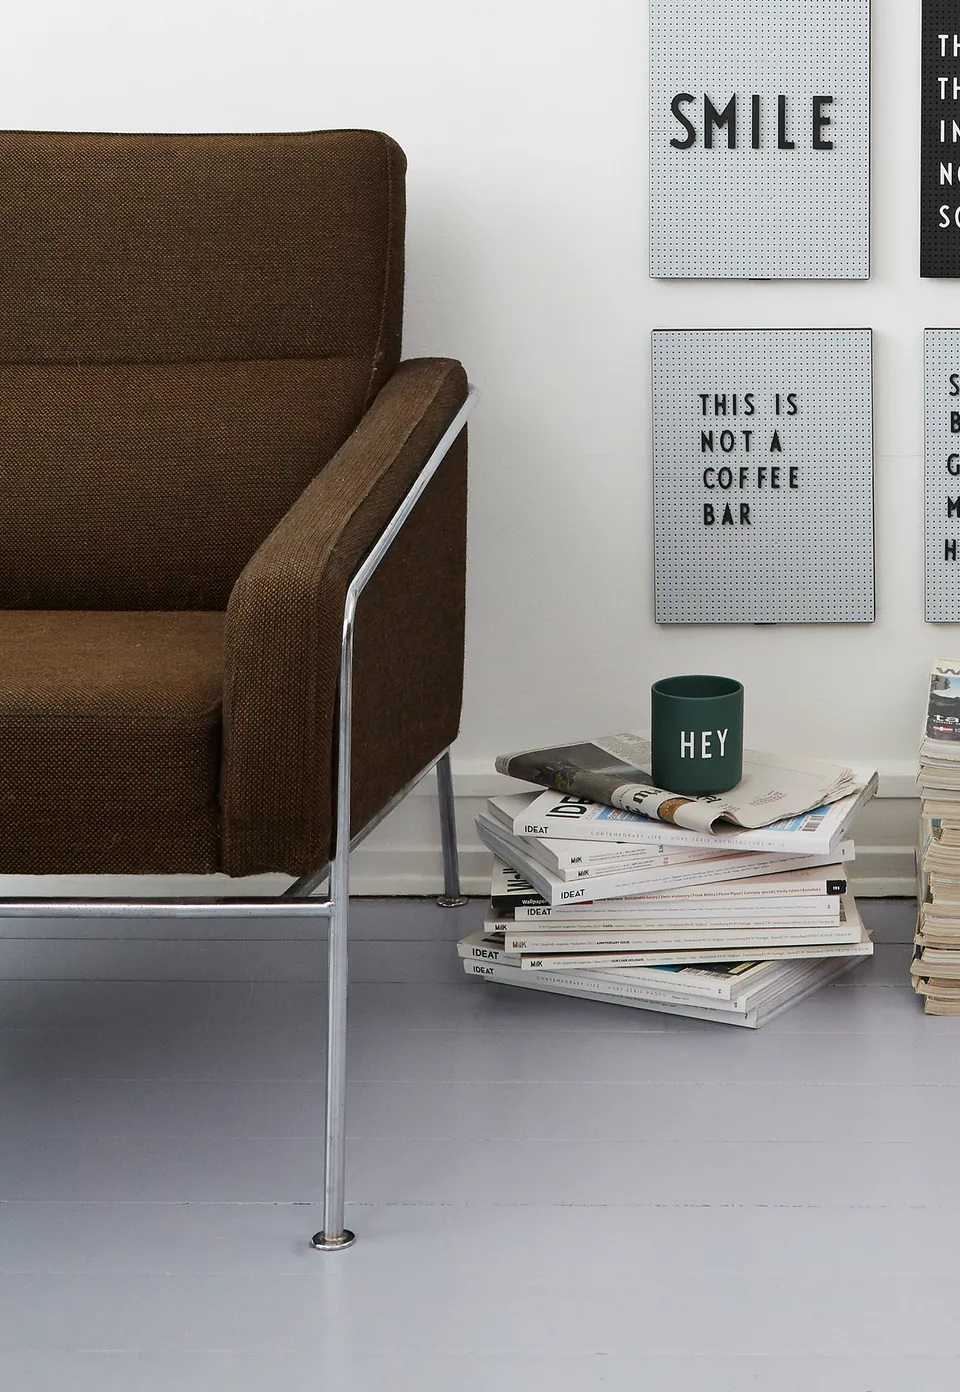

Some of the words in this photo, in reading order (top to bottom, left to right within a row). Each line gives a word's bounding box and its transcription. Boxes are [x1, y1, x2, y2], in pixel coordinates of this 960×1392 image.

[669, 92, 834, 151] SMILE
[697, 392, 755, 417] THIS
[775, 392, 798, 416] IS
[700, 429, 753, 453] NOT
[769, 428, 783, 453] A
[702, 466, 799, 490] COFFEE
[703, 501, 752, 526] BAR
[679, 728, 729, 759] HEY
[524, 825, 549, 834] IDEAT
[560, 889, 585, 900] IDEAT
[527, 908, 552, 916] IDEAT
[472, 948, 499, 960] IDEAT
[472, 966, 495, 975] IDEAT
